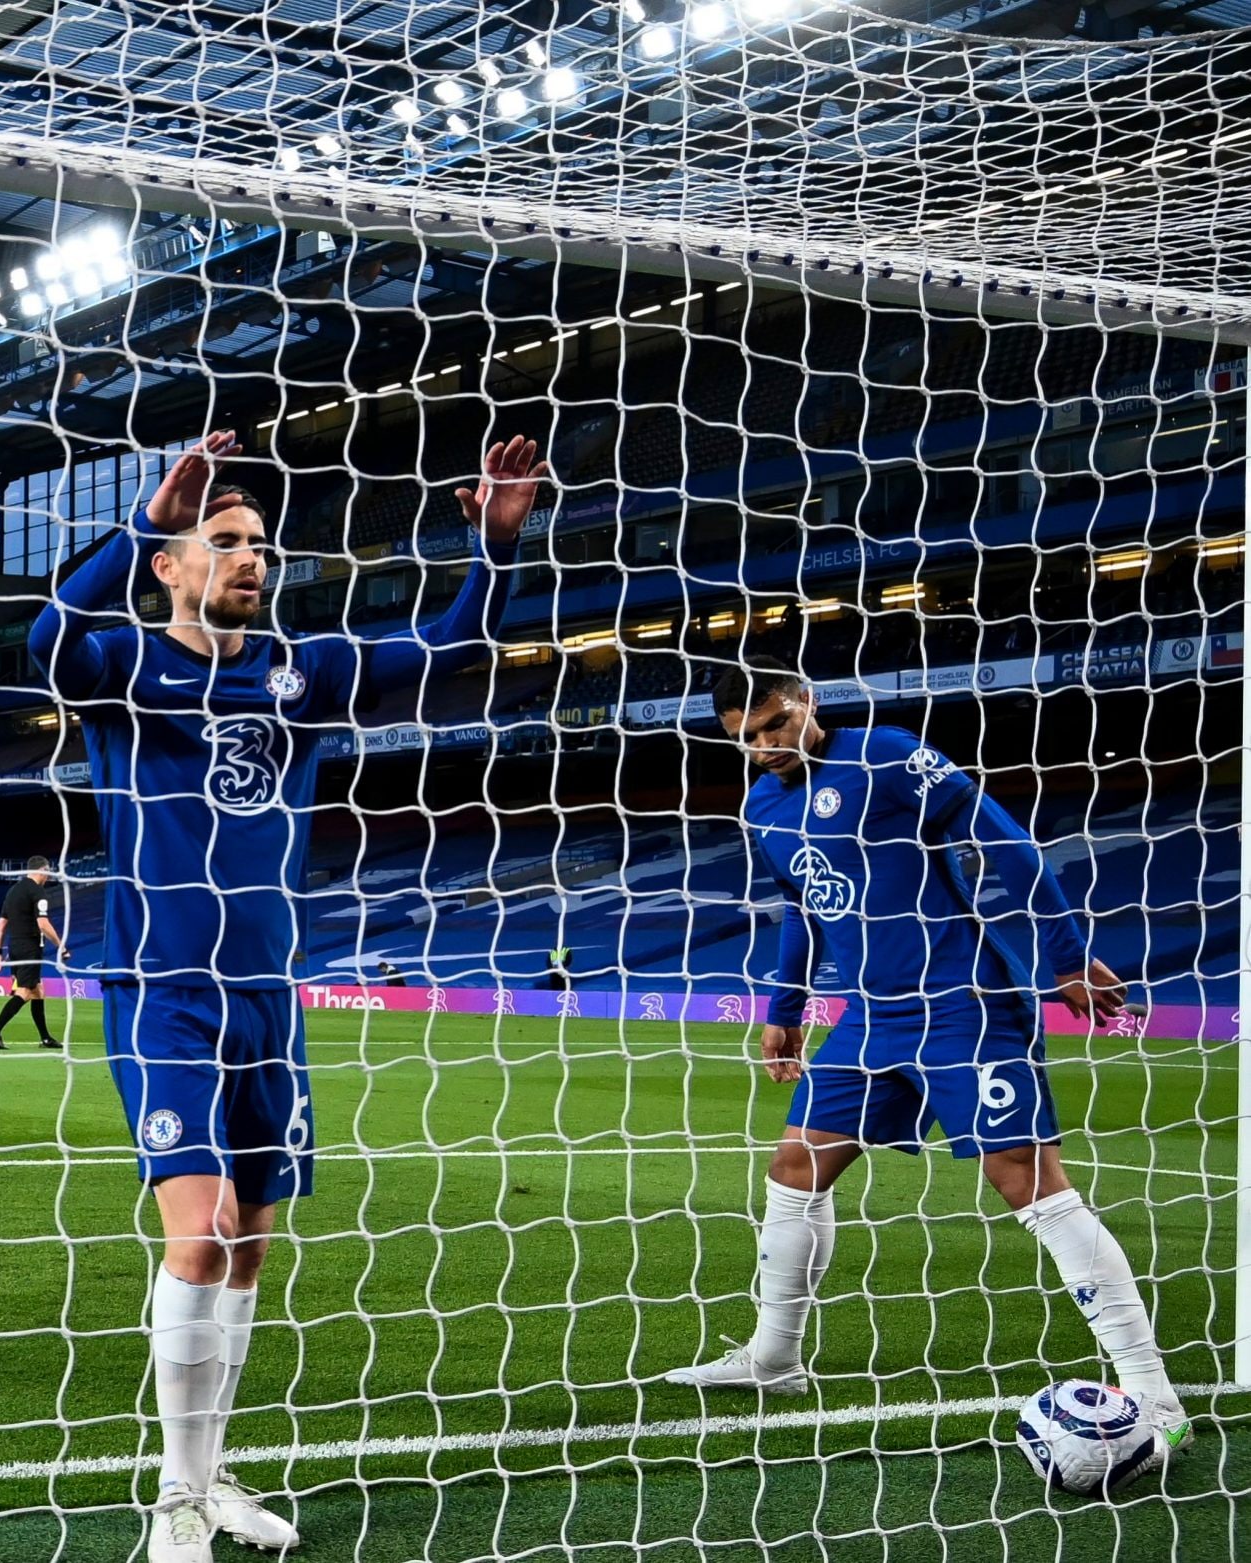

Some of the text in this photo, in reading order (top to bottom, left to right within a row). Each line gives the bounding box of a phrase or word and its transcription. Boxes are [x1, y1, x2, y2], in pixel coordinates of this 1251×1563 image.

[802, 544, 901, 570] CHELSEA FC
[1061, 644, 1144, 667] CHELSEA
[1061, 659, 1143, 681] CROATIA
[823, 688, 861, 700] bridges
[307, 986, 385, 1010] Three
[980, 1065, 1016, 1109] 6
